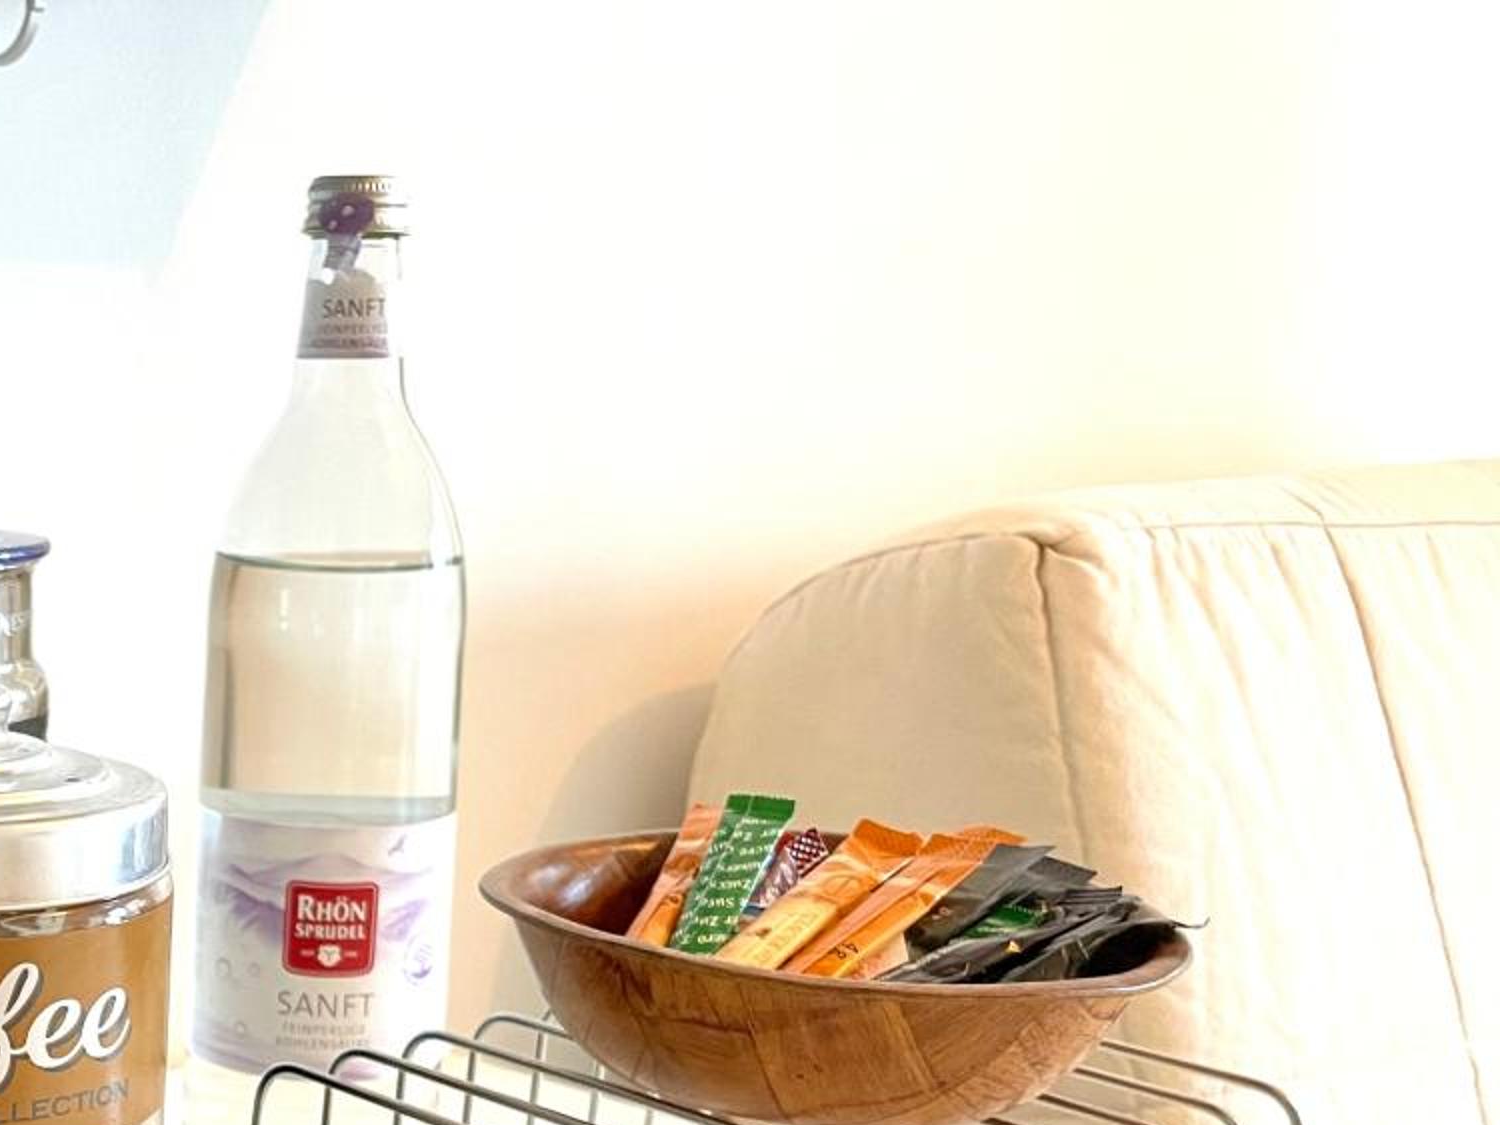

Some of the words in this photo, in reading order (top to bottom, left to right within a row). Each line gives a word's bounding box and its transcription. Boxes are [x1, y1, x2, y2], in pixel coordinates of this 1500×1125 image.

[323, 298, 386, 319] SANFT
[297, 894, 368, 922] RHÖN
[294, 922, 367, 941] SPRUDEL
[277, 989, 375, 1018] SANFT
